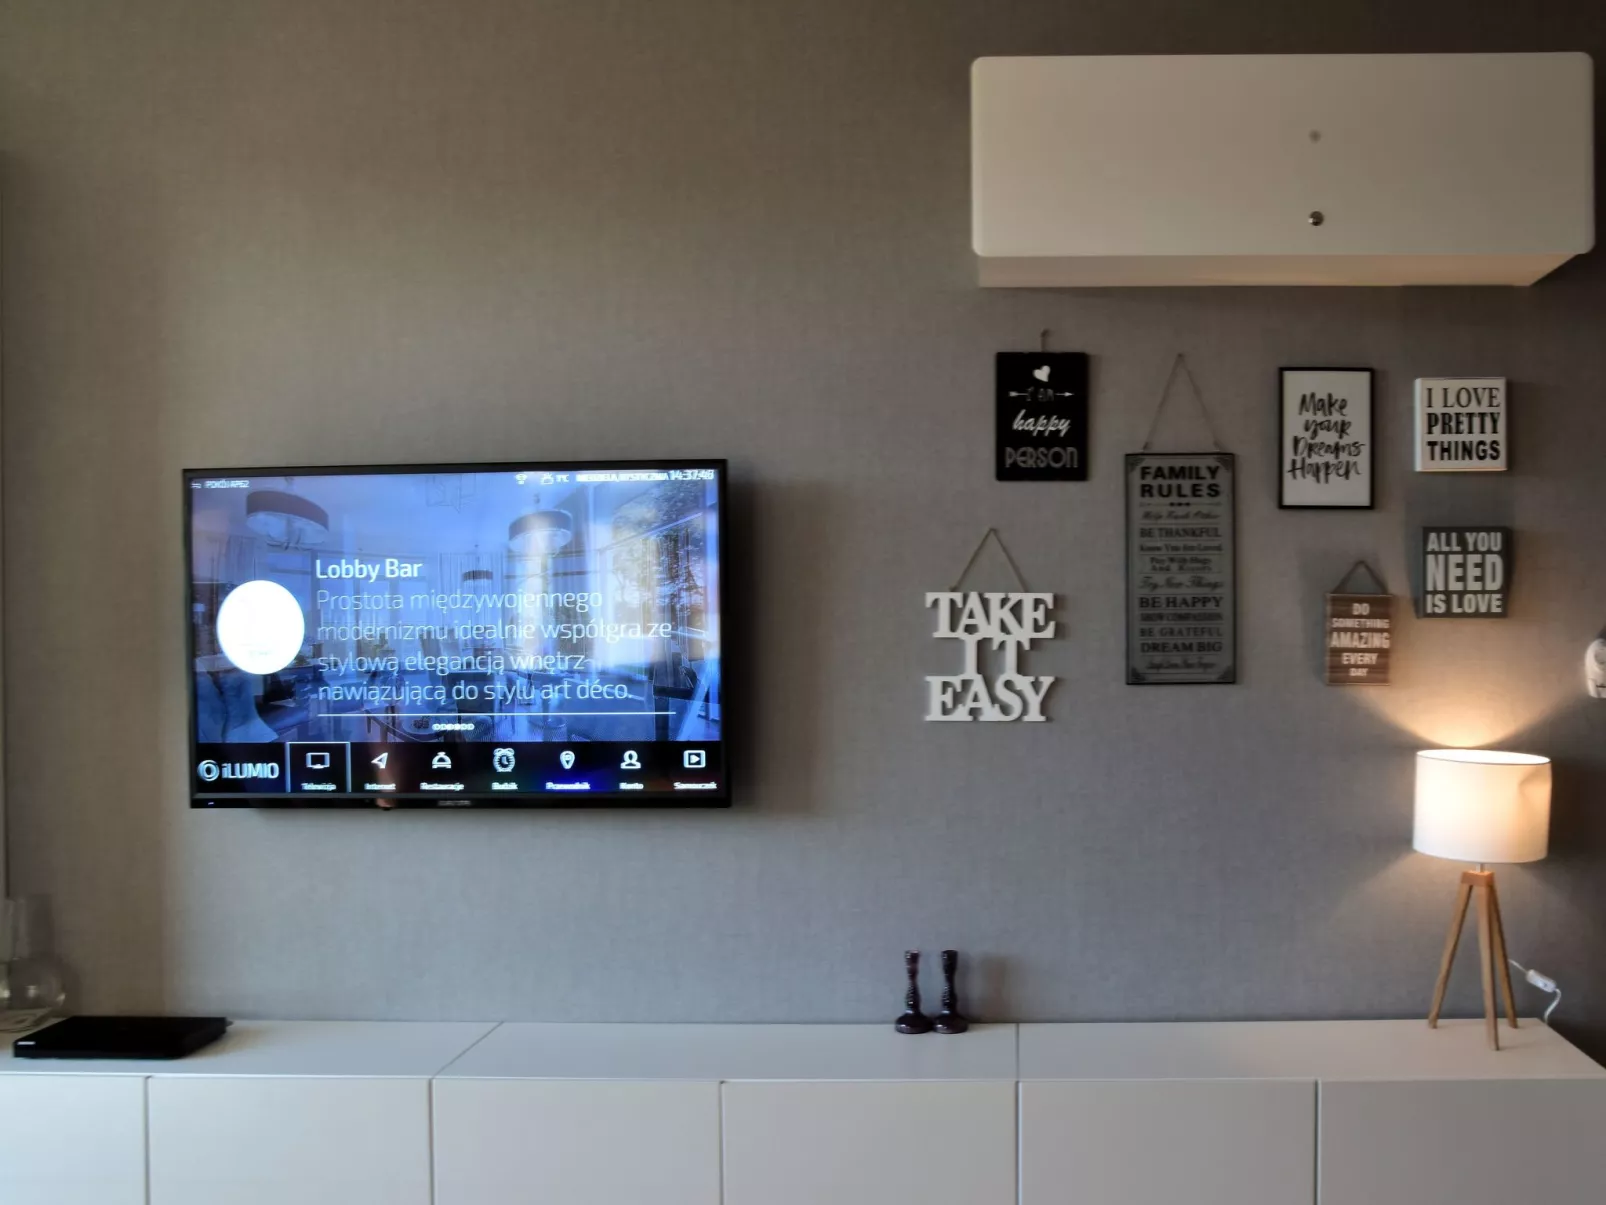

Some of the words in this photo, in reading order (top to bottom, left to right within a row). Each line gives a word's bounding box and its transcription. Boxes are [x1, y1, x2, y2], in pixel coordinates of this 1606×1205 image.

[1299, 392, 1348, 417] Make
[1425, 387, 1434, 408] I
[1442, 387, 1501, 408] LOVE
[1012, 408, 1072, 437] happy
[1426, 411, 1501, 435] PRETTY
[1426, 439, 1501, 461] THINGS
[1140, 465, 1220, 480] FAMILY
[1287, 457, 1363, 485] Happen
[1140, 482, 1221, 498] RULES
[1139, 527, 1154, 538] BE
[1158, 527, 1223, 538] THANKFUL
[1427, 532, 1462, 552] ALL
[1465, 532, 1502, 552] YOU
[315, 559, 380, 583] Lobby
[384, 558, 423, 578] Bar
[1425, 553, 1504, 591] NEED
[316, 589, 404, 610] Prostota
[410, 588, 603, 614] międzywojennego
[1139, 596, 1162, 608] BE
[1165, 596, 1224, 608] HAPPY
[1352, 603, 1370, 615] DO
[1426, 593, 1447, 614] IS
[1451, 593, 1503, 614] LOVE
[925, 592, 1056, 638] TAKE
[316, 620, 448, 641] modernizmu
[453, 619, 536, 640] idealnie
[541, 618, 642, 644] współgra
[648, 622, 672, 638] ze
[1139, 627, 1155, 637] BE
[1159, 626, 1223, 637] GRATEFUL
[1330, 631, 1390, 649] AMAZING
[958, 633, 1031, 677] IT
[1140, 641, 1194, 653] DREAM
[1197, 641, 1223, 653] BIG
[317, 651, 400, 676] stylową
[404, 650, 505, 676] elegancją
[509, 651, 586, 675] wnętrz
[318, 680, 447, 706] nawiązującą
[452, 680, 479, 701] do
[483, 679, 535, 705] stylu
[540, 680, 573, 699] art
[576, 678, 633, 700] déco.
[925, 674, 1056, 722] EASY
